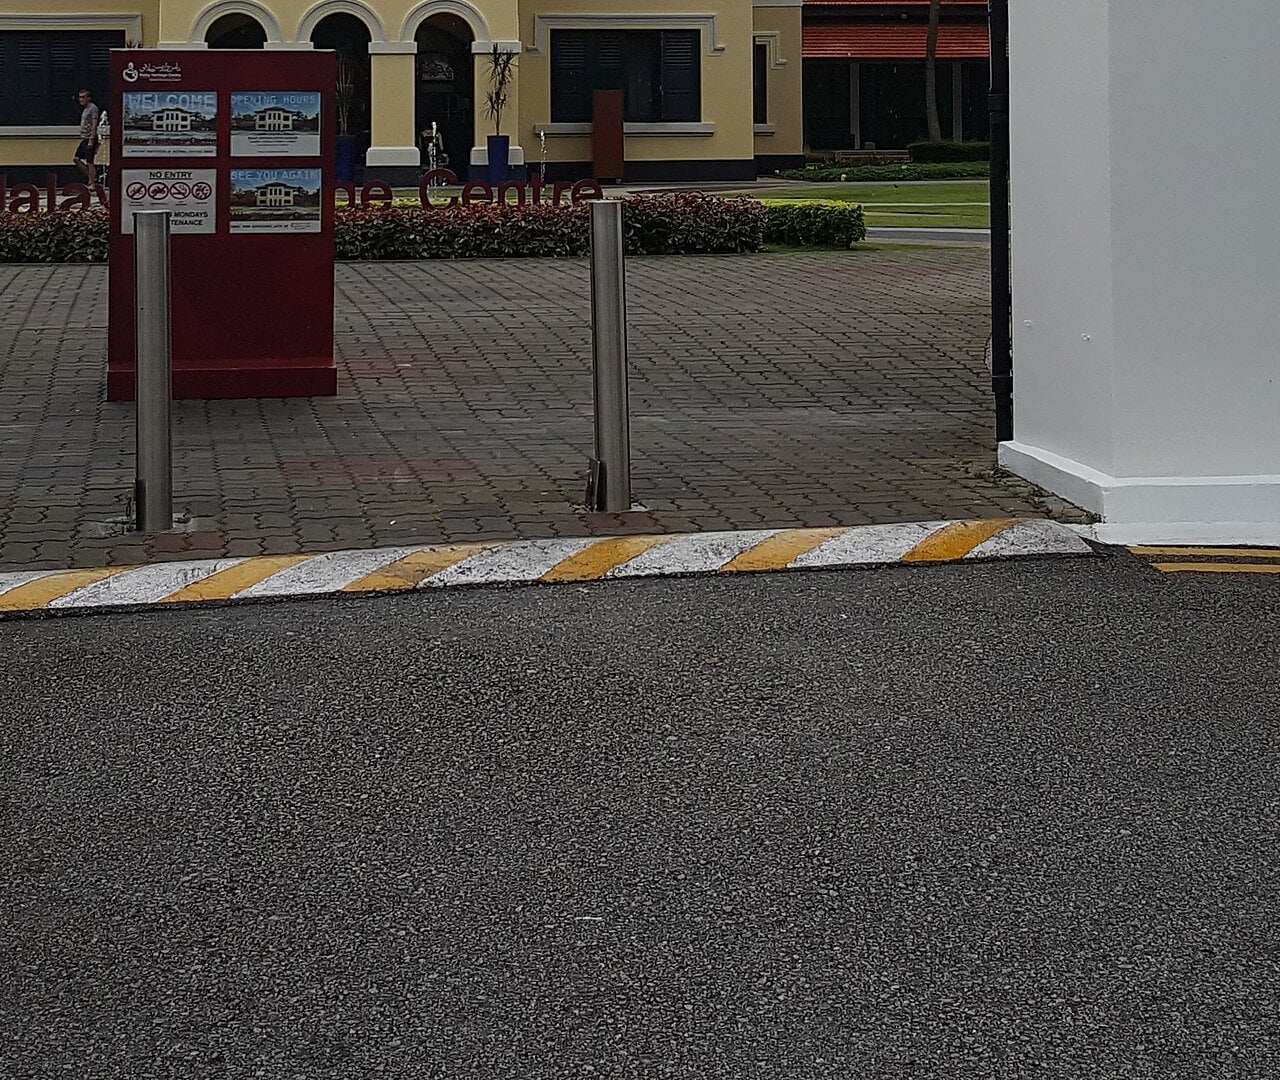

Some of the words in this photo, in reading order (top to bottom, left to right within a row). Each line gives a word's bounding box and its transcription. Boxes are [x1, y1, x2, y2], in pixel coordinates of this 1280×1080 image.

[128, 94, 215, 109] WELCOME
[231, 95, 276, 104] OPENING
[283, 95, 316, 104] HOURS
[231, 170, 254, 180] SEE
[258, 170, 277, 180] YOU
[282, 170, 319, 180] AGAIN
[421, 169, 603, 210] Centre
